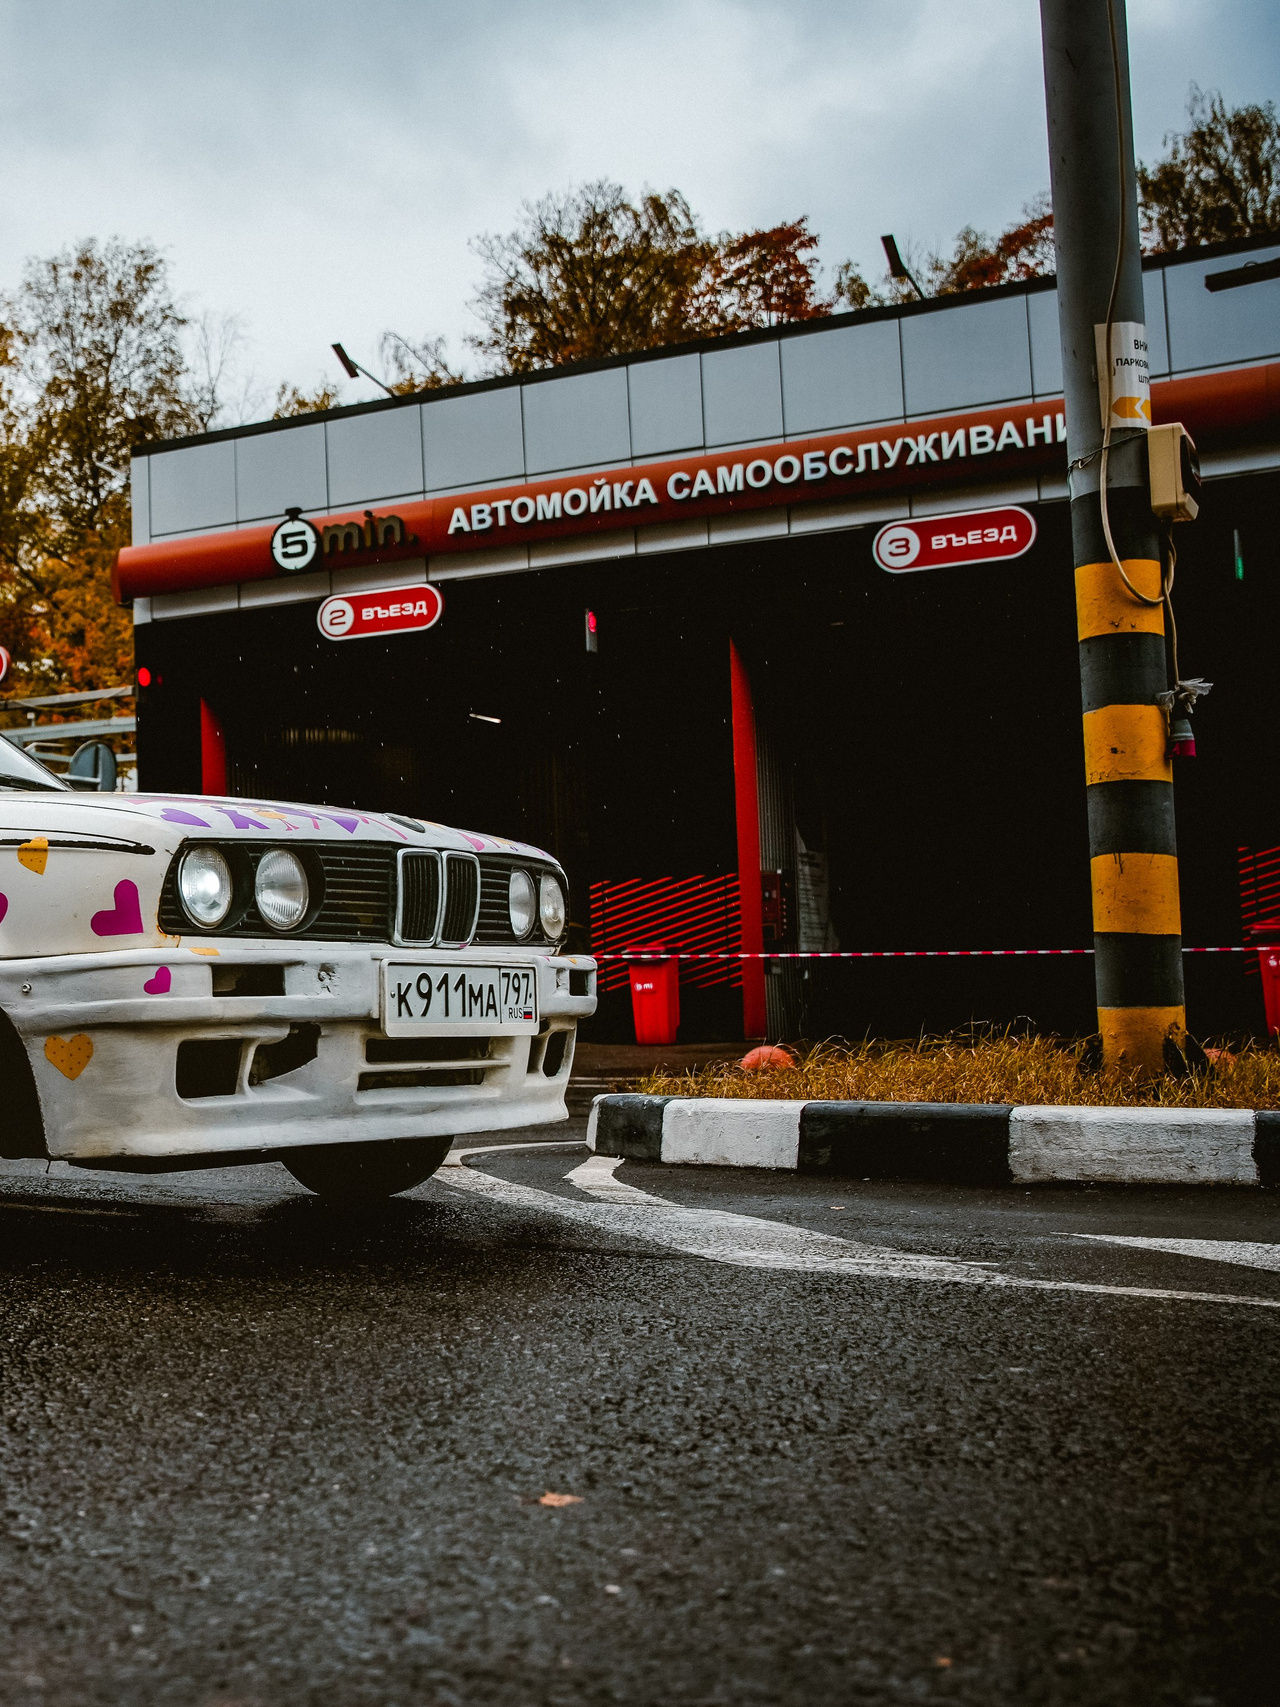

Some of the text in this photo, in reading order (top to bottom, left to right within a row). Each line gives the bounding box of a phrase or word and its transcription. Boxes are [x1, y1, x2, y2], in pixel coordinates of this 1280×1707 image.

[447, 477, 659, 535] АВТОМОЙКА
[280, 530, 309, 560] 5
[888, 525, 1018, 557] 3 ВЪЕЗД
[329, 600, 428, 626] 2 ВЪЕЗД
[501, 972, 530, 1006] 797
[508, 1007, 523, 1019] RUS
